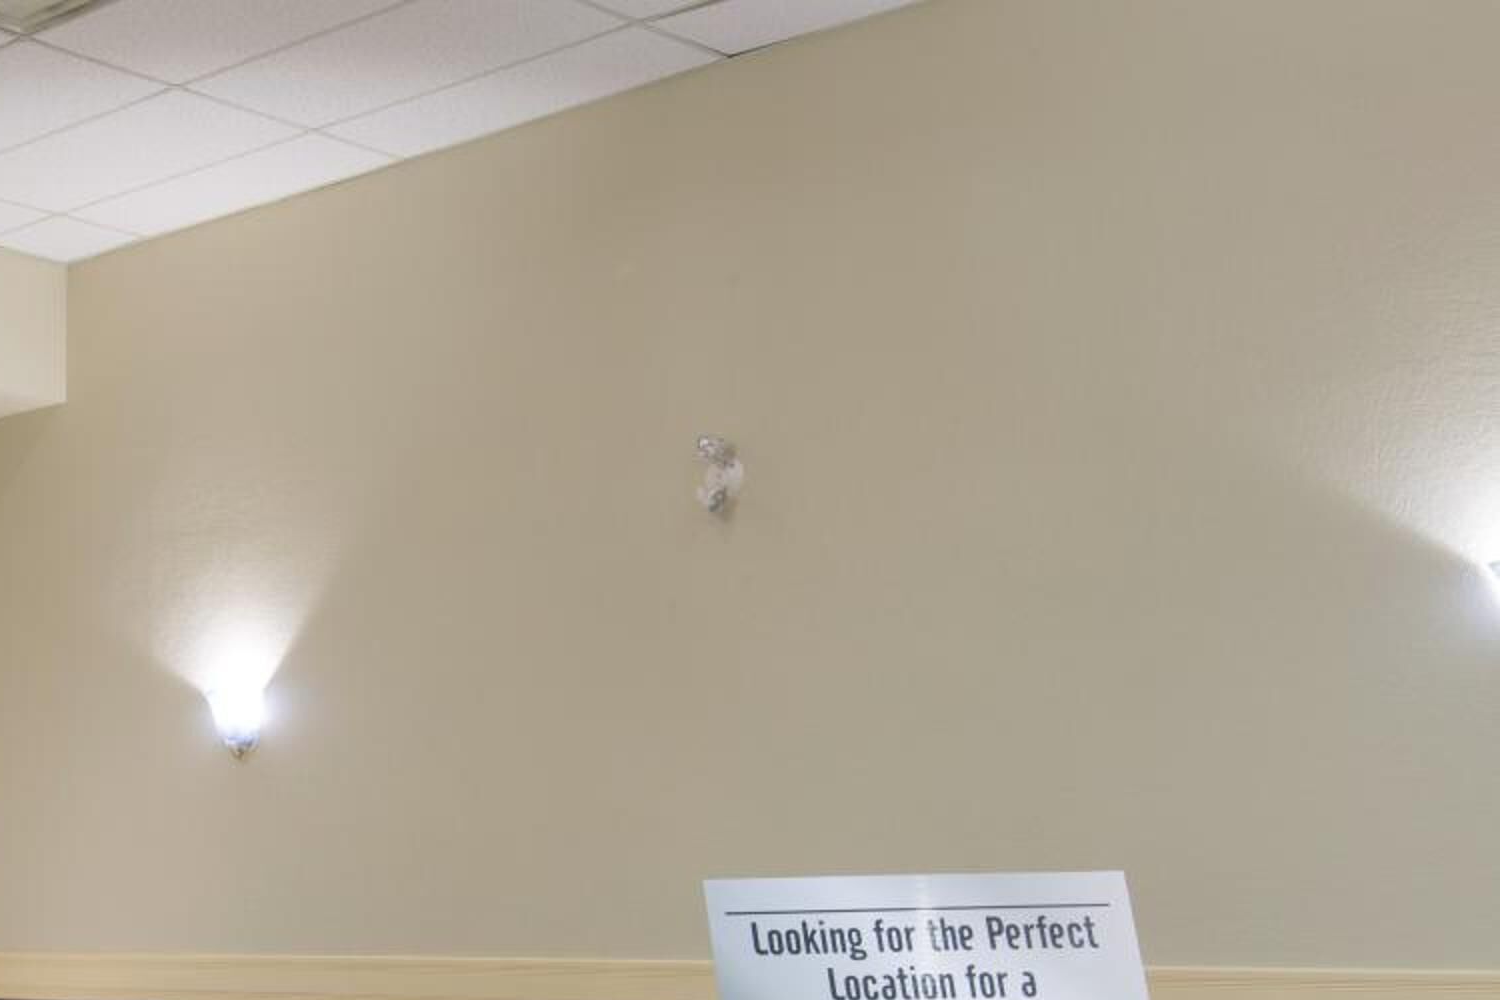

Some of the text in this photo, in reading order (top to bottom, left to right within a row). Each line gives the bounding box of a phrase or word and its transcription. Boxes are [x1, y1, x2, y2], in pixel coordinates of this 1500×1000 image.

[751, 915, 1100, 961] Looking for the Perfect
[965, 963, 1008, 999] for
[1021, 971, 1038, 998] a
